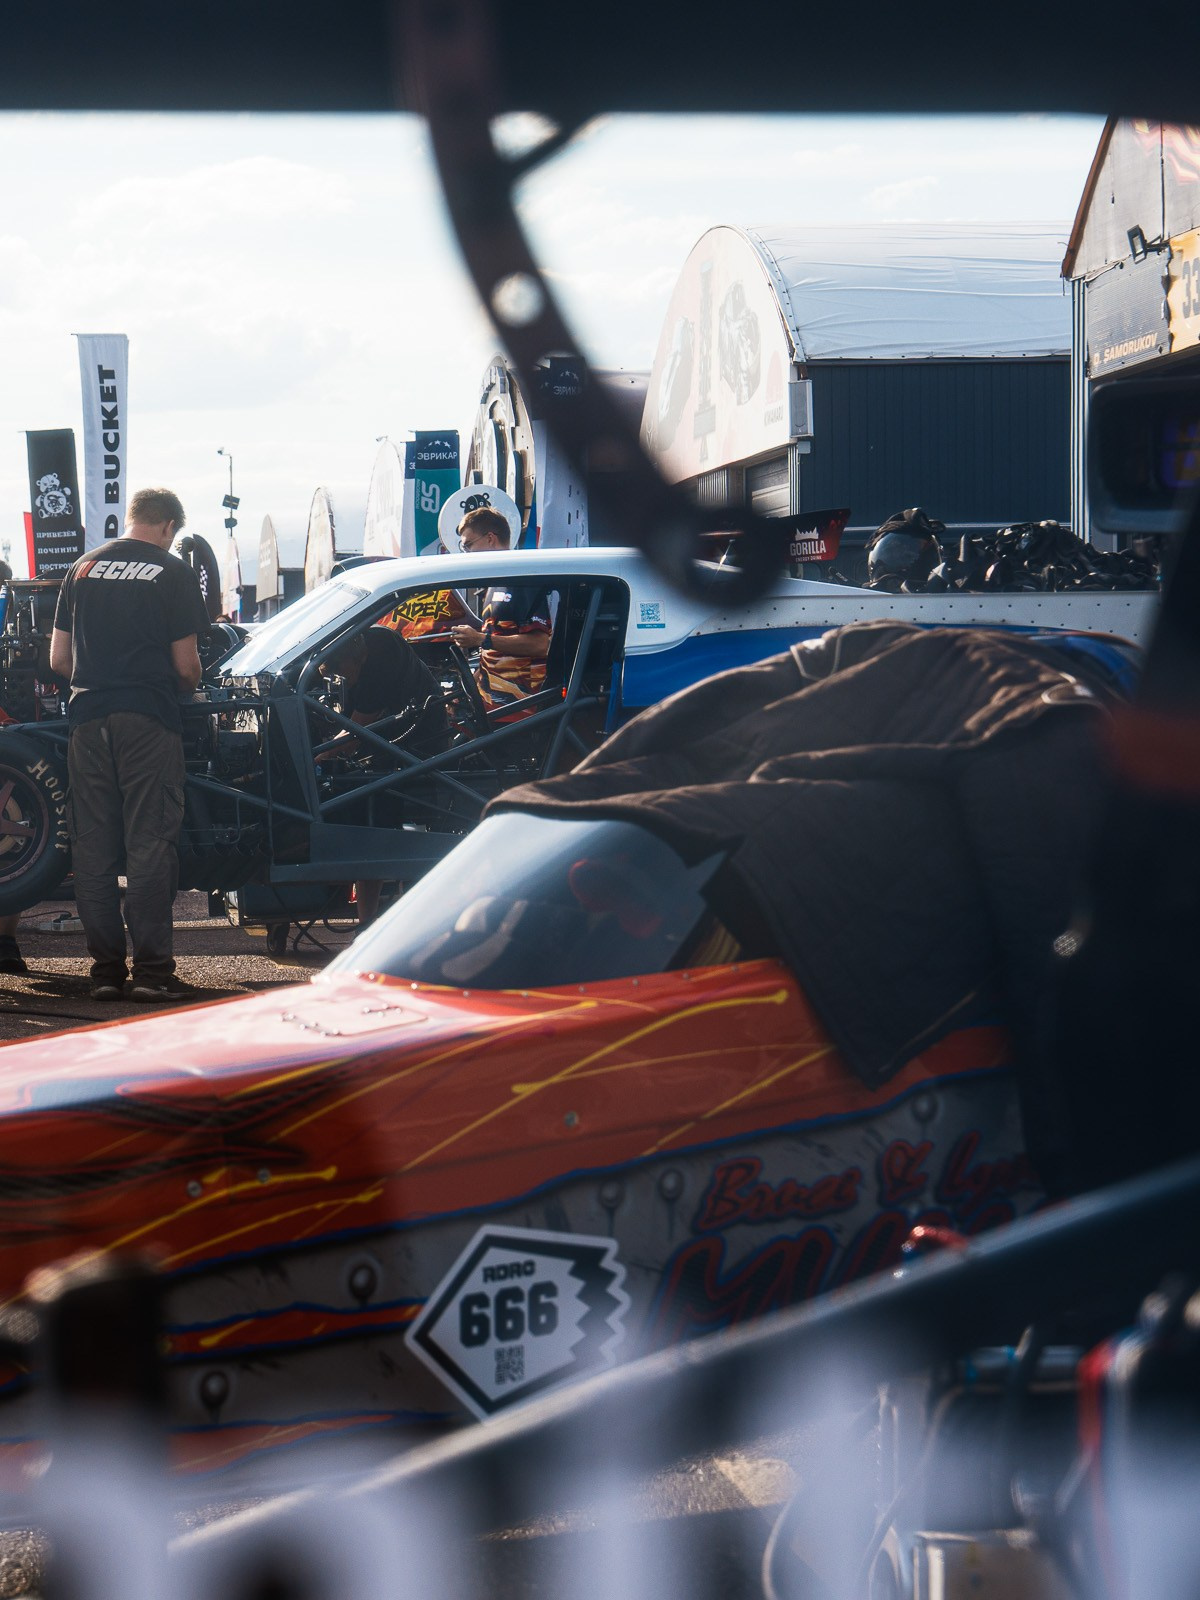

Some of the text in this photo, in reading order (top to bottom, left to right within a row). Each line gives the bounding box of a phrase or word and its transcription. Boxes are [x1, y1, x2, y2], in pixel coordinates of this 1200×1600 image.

[1103, 332, 1158, 363] SAMORUKOV
[97, 364, 121, 504] BUCKET
[417, 451, 458, 461] ЭВРИКАР
[37, 546, 78, 554] ПОЧИНИМ
[789, 539, 827, 556] GORILLA
[88, 560, 164, 582] ECHO
[392, 600, 451, 622] RIDER
[459, 1281, 559, 1348] 666
